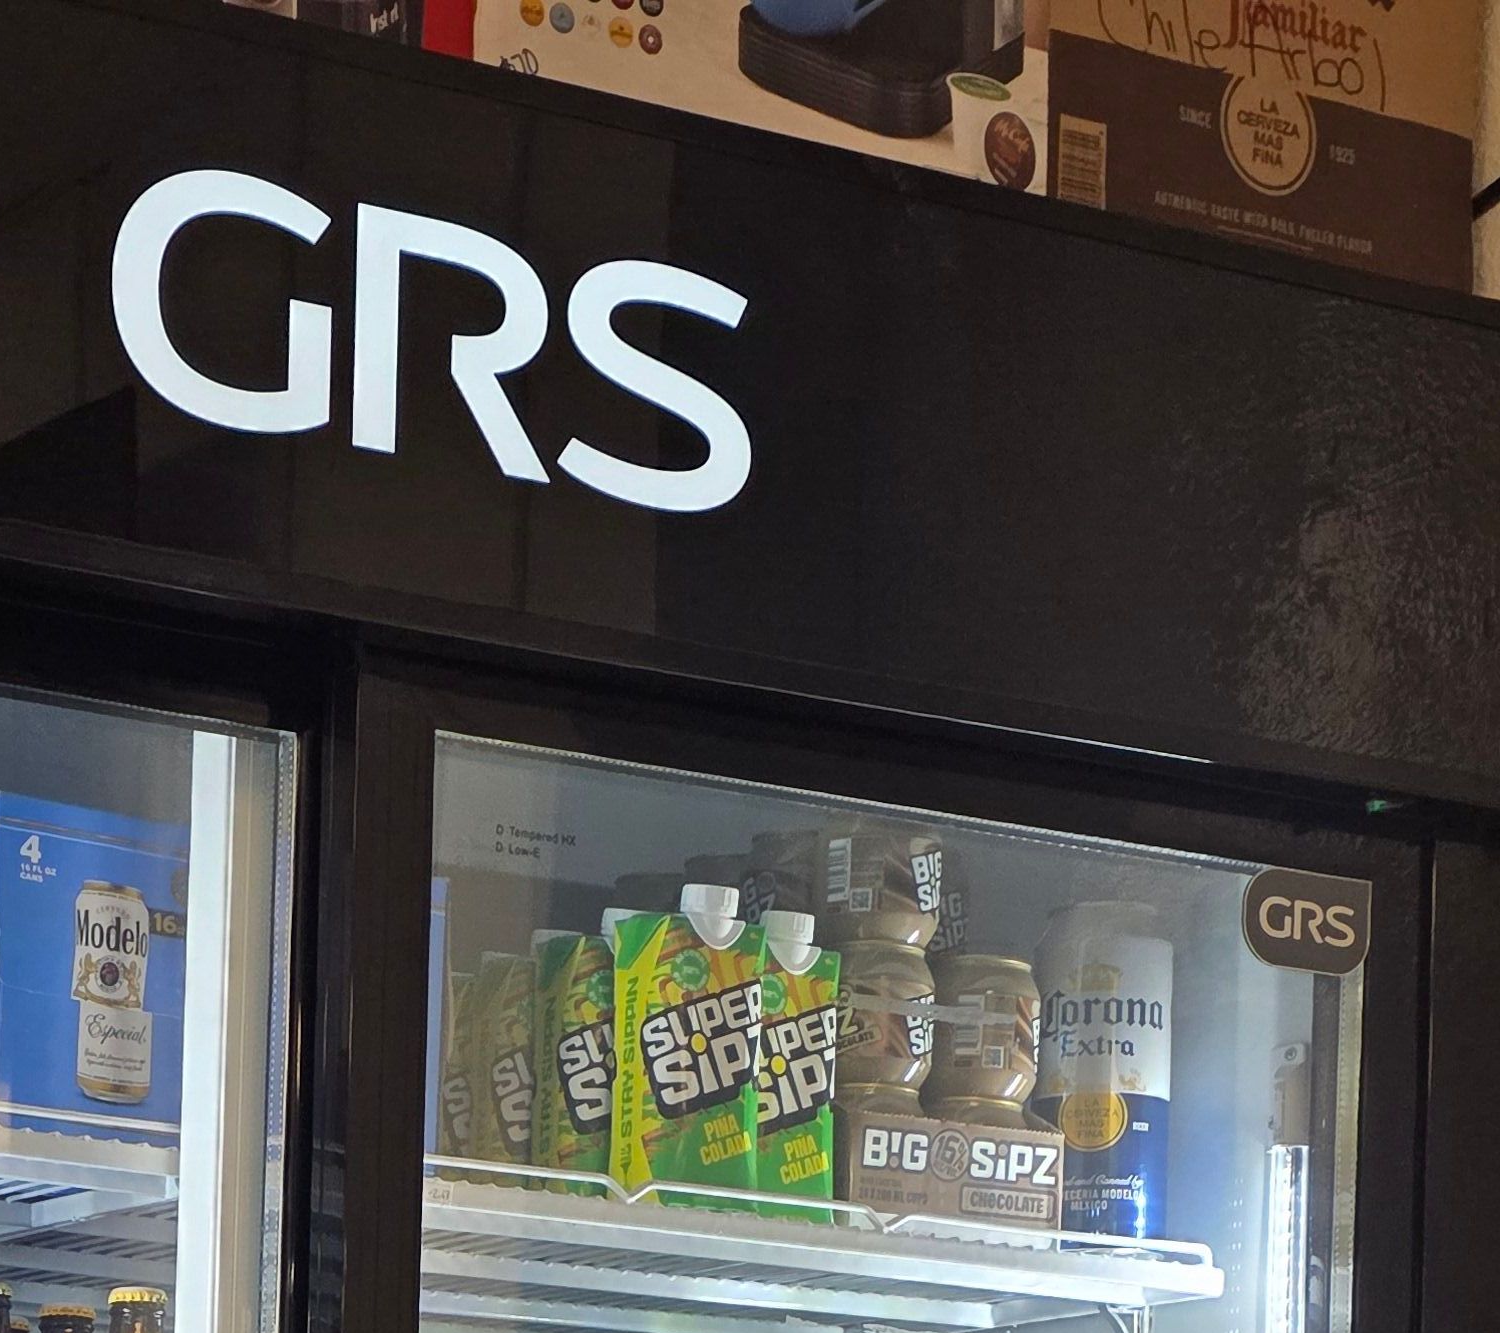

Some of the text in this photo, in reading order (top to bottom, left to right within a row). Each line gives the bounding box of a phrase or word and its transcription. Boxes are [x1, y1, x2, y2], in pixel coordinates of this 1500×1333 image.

[1260, 98, 1277, 113] LA
[1236, 110, 1300, 139] CERVEZA
[1253, 131, 1284, 151] MAS
[1252, 148, 1283, 168] FINA
[111, 168, 753, 513] GRS
[19, 834, 42, 864] 4
[76, 909, 149, 958] Modelo
[1258, 895, 1356, 948] GRS
[642, 982, 763, 1058] SUPER
[1041, 987, 1165, 1039] Corona
[1059, 1028, 1136, 1059] Extra
[704, 1111, 740, 1142] PIÑA
[700, 1131, 753, 1166] COLADA
[783, 1133, 817, 1161] PIÑA
[779, 1152, 830, 1185] COLADA
[969, 1188, 1045, 1214] CHOCOLATE
